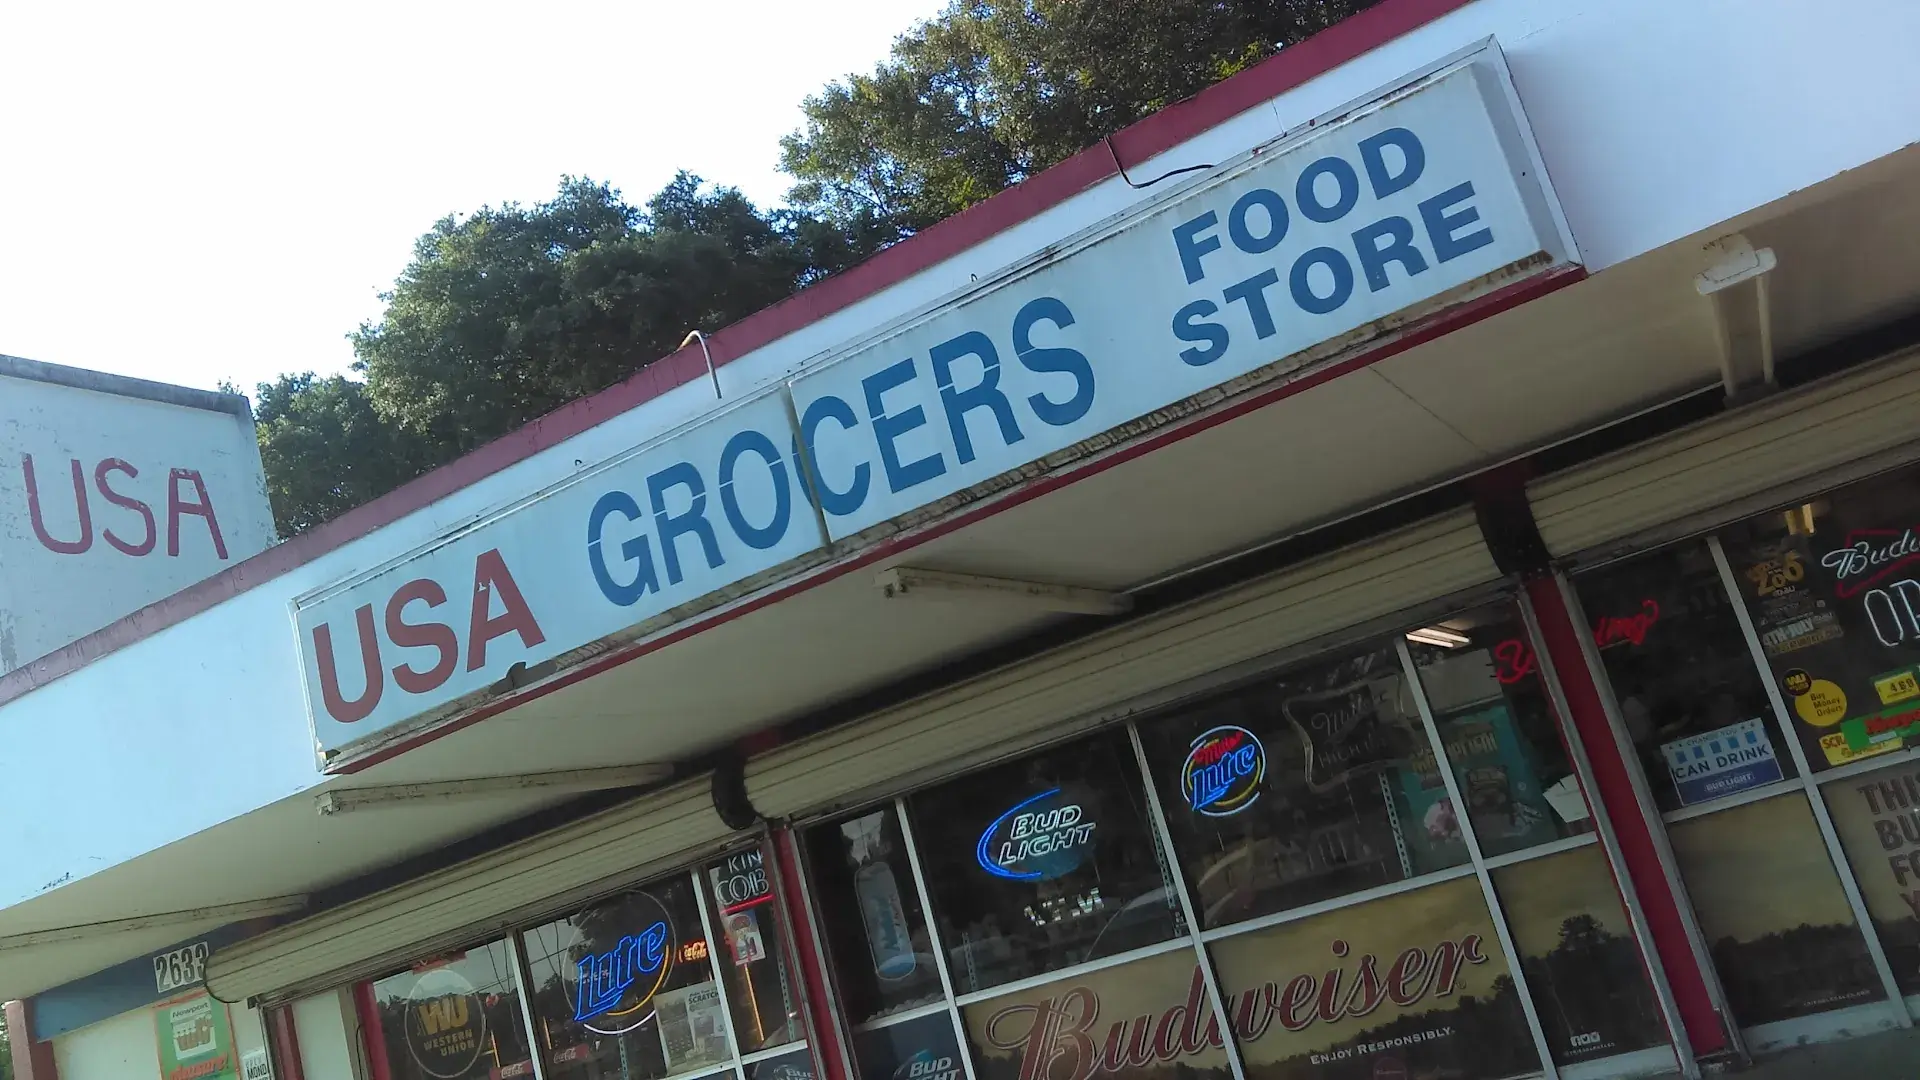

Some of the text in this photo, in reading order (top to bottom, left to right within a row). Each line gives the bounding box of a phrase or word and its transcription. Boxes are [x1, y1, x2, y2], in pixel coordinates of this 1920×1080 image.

[1172, 127, 1426, 285] FOOD
[1172, 180, 1494, 367] STORE
[21, 452, 229, 560] USA
[312, 296, 1095, 723] USA GROCERS
[1674, 744, 1770, 779] CAN DRINK
[1856, 773, 1920, 815] THI
[1009, 804, 1082, 841] BUD
[998, 822, 1097, 865] LIGHT
[172, 1002, 209, 1019] Newport
[416, 996, 469, 1037] WU
[985, 933, 1488, 1080] Budweiser
[423, 1031, 474, 1053] WESTERN
[439, 1040, 477, 1058] UNION
[1309, 1048, 1353, 1066] ENJOY
[909, 1056, 952, 1077] BUD
